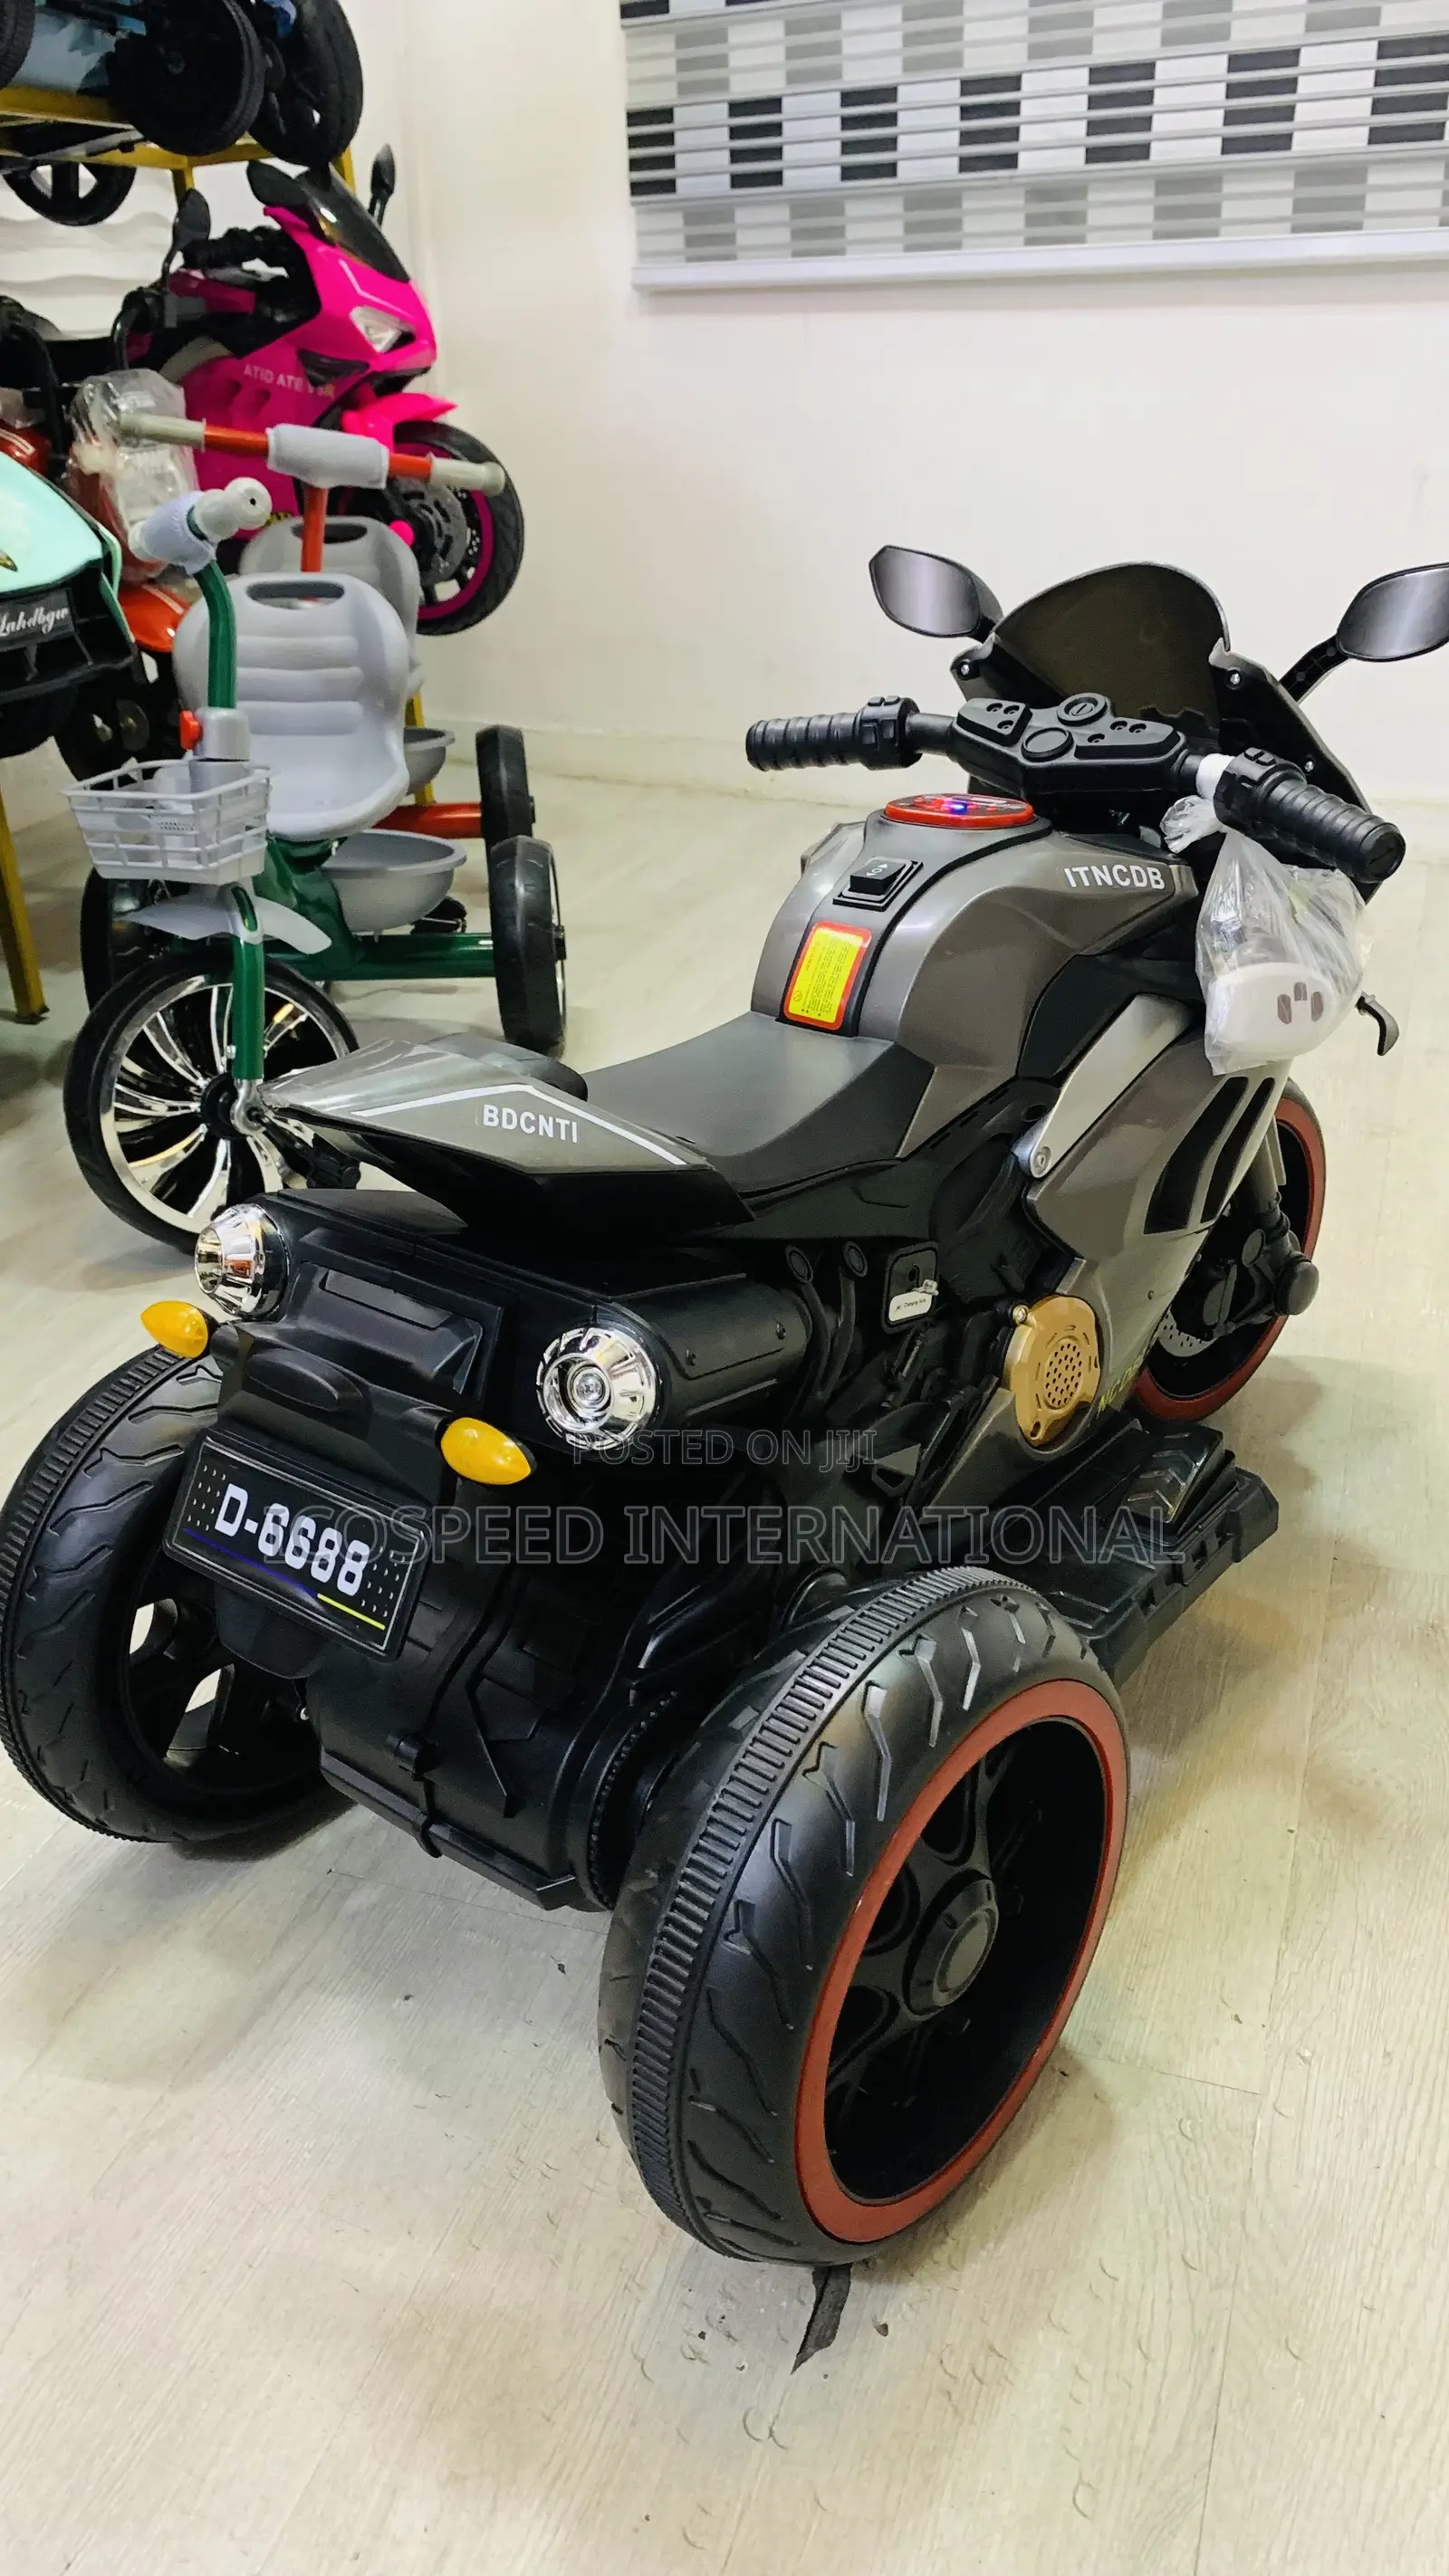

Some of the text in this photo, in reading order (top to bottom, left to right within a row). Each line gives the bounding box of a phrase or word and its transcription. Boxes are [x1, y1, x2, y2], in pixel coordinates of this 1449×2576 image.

[1064, 864, 1166, 890] ITNCDB
[483, 1104, 578, 1143] BDCNTI
[215, 1482, 370, 1596] D-6688
